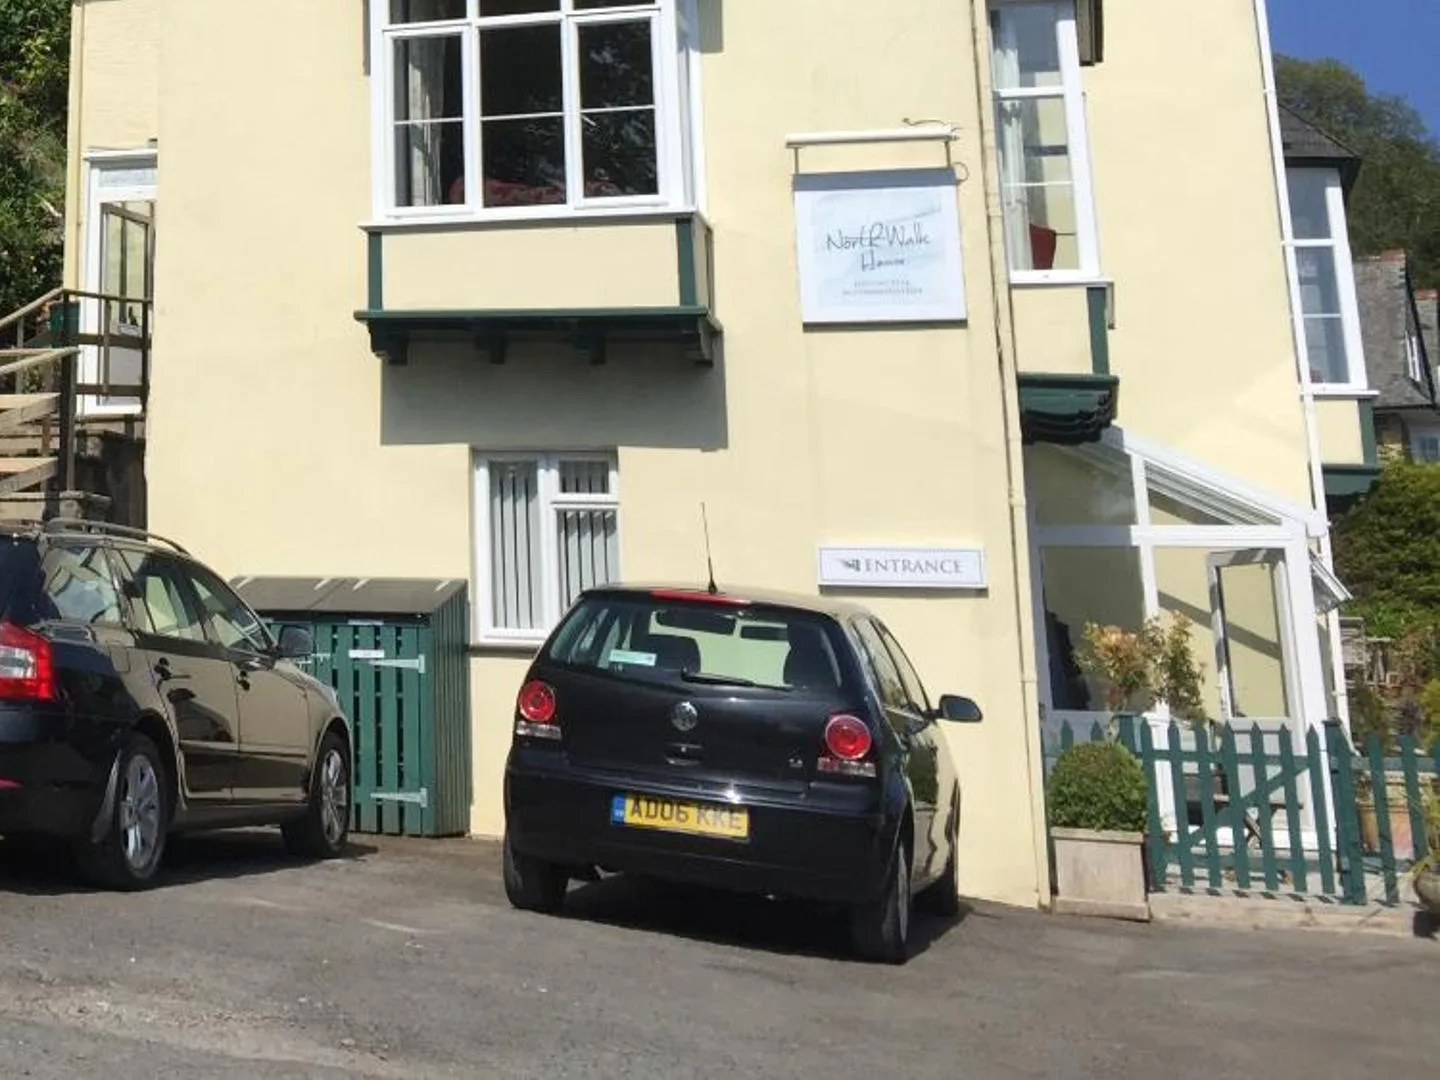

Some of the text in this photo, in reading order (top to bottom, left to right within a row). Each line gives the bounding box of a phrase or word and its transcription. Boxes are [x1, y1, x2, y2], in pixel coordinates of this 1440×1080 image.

[825, 222, 885, 251] North
[864, 558, 964, 574] ENTRANCE
[630, 796, 690, 823] AD06
